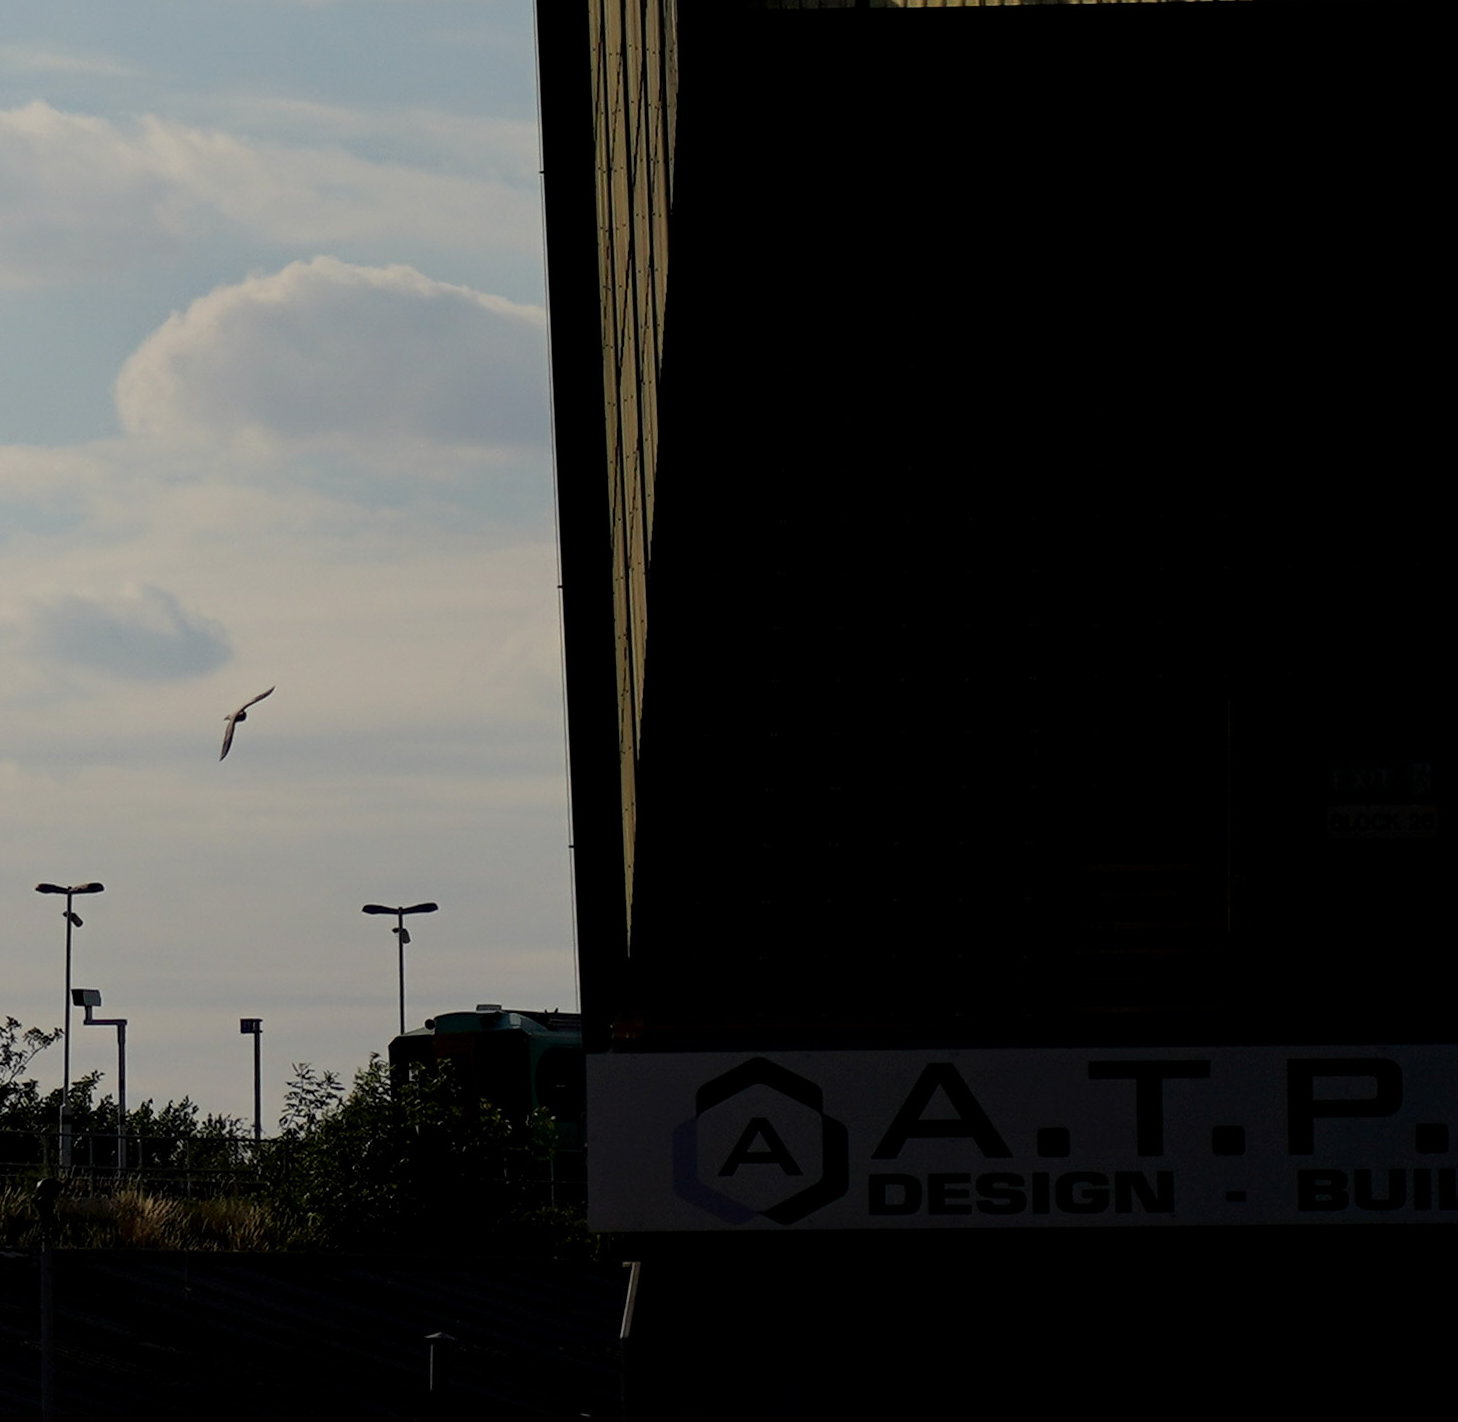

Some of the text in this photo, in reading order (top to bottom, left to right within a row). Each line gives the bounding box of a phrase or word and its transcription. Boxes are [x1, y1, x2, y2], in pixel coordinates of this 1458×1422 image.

[1331, 768, 1390, 791] EXIT
[1330, 813, 1398, 832] BLOCK
[718, 1117, 803, 1178] A
[869, 1170, 1176, 1216] DESIGN
